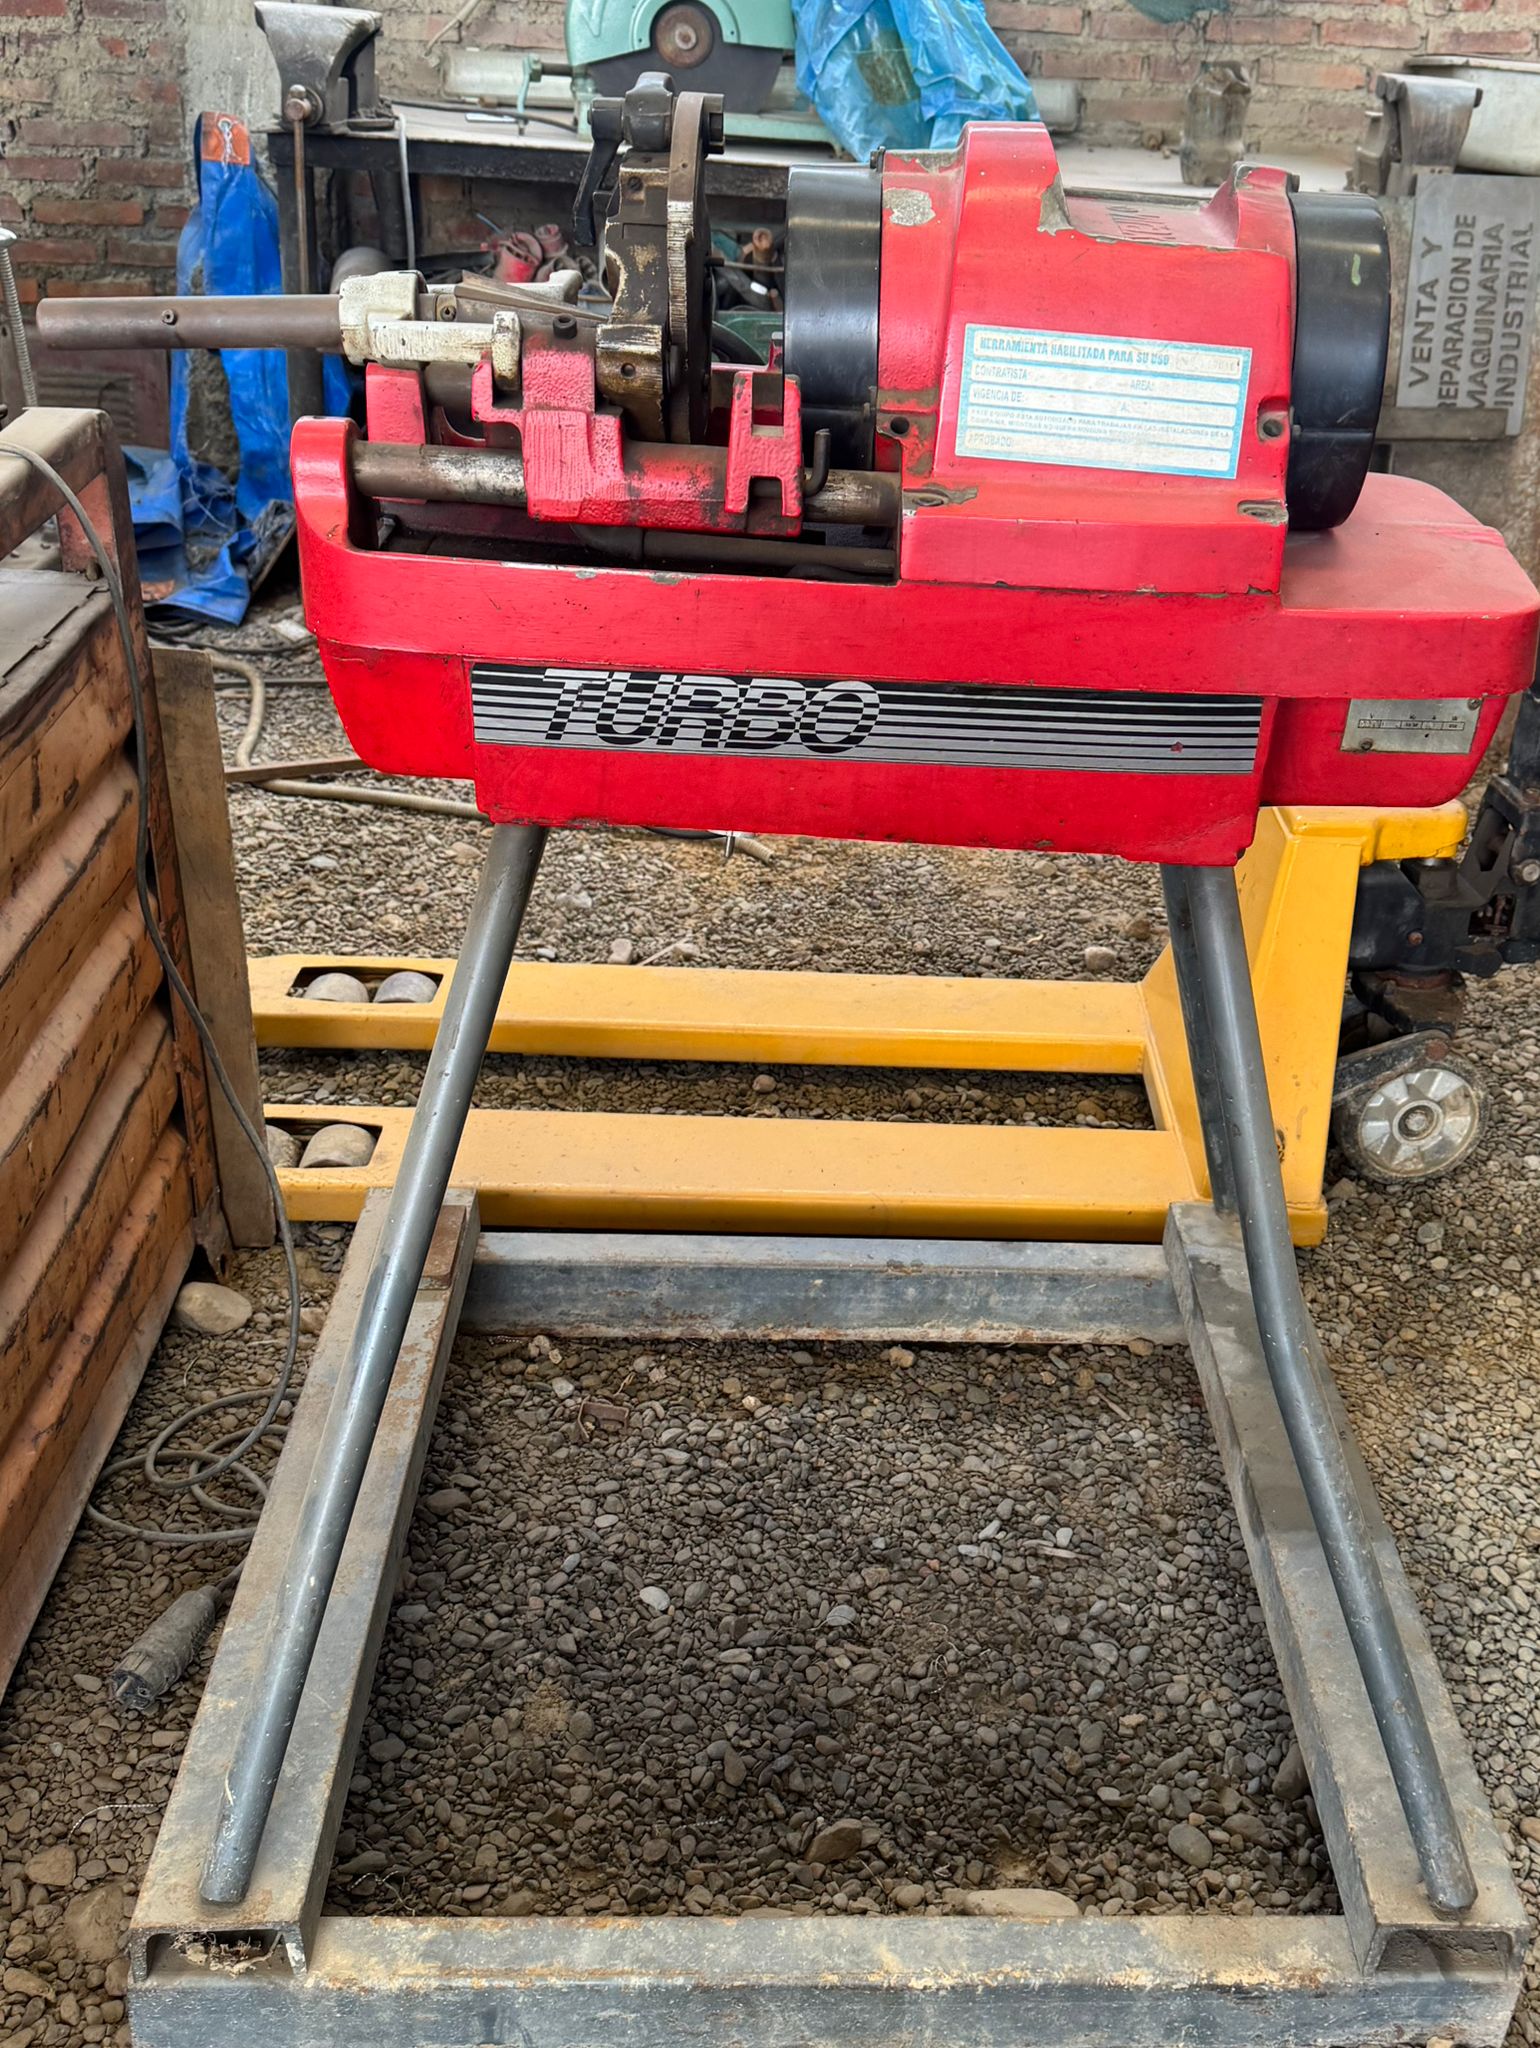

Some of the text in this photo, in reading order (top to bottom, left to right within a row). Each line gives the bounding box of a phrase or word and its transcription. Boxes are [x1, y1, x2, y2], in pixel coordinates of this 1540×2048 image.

[1453, 214, 1476, 248] DE
[1408, 237, 1442, 388] VENTA Y
[1494, 223, 1534, 407] INDUSTRIAL
[980, 336, 1048, 355] HERRAMIENTA
[1050, 343, 1106, 361] HABILITADA
[1108, 349, 1133, 363] PARA
[1136, 352, 1149, 364] SU
[1150, 352, 1170, 366] USO
[973, 388, 1009, 401] VIGENCIA
[543, 668, 880, 753] TURBO
